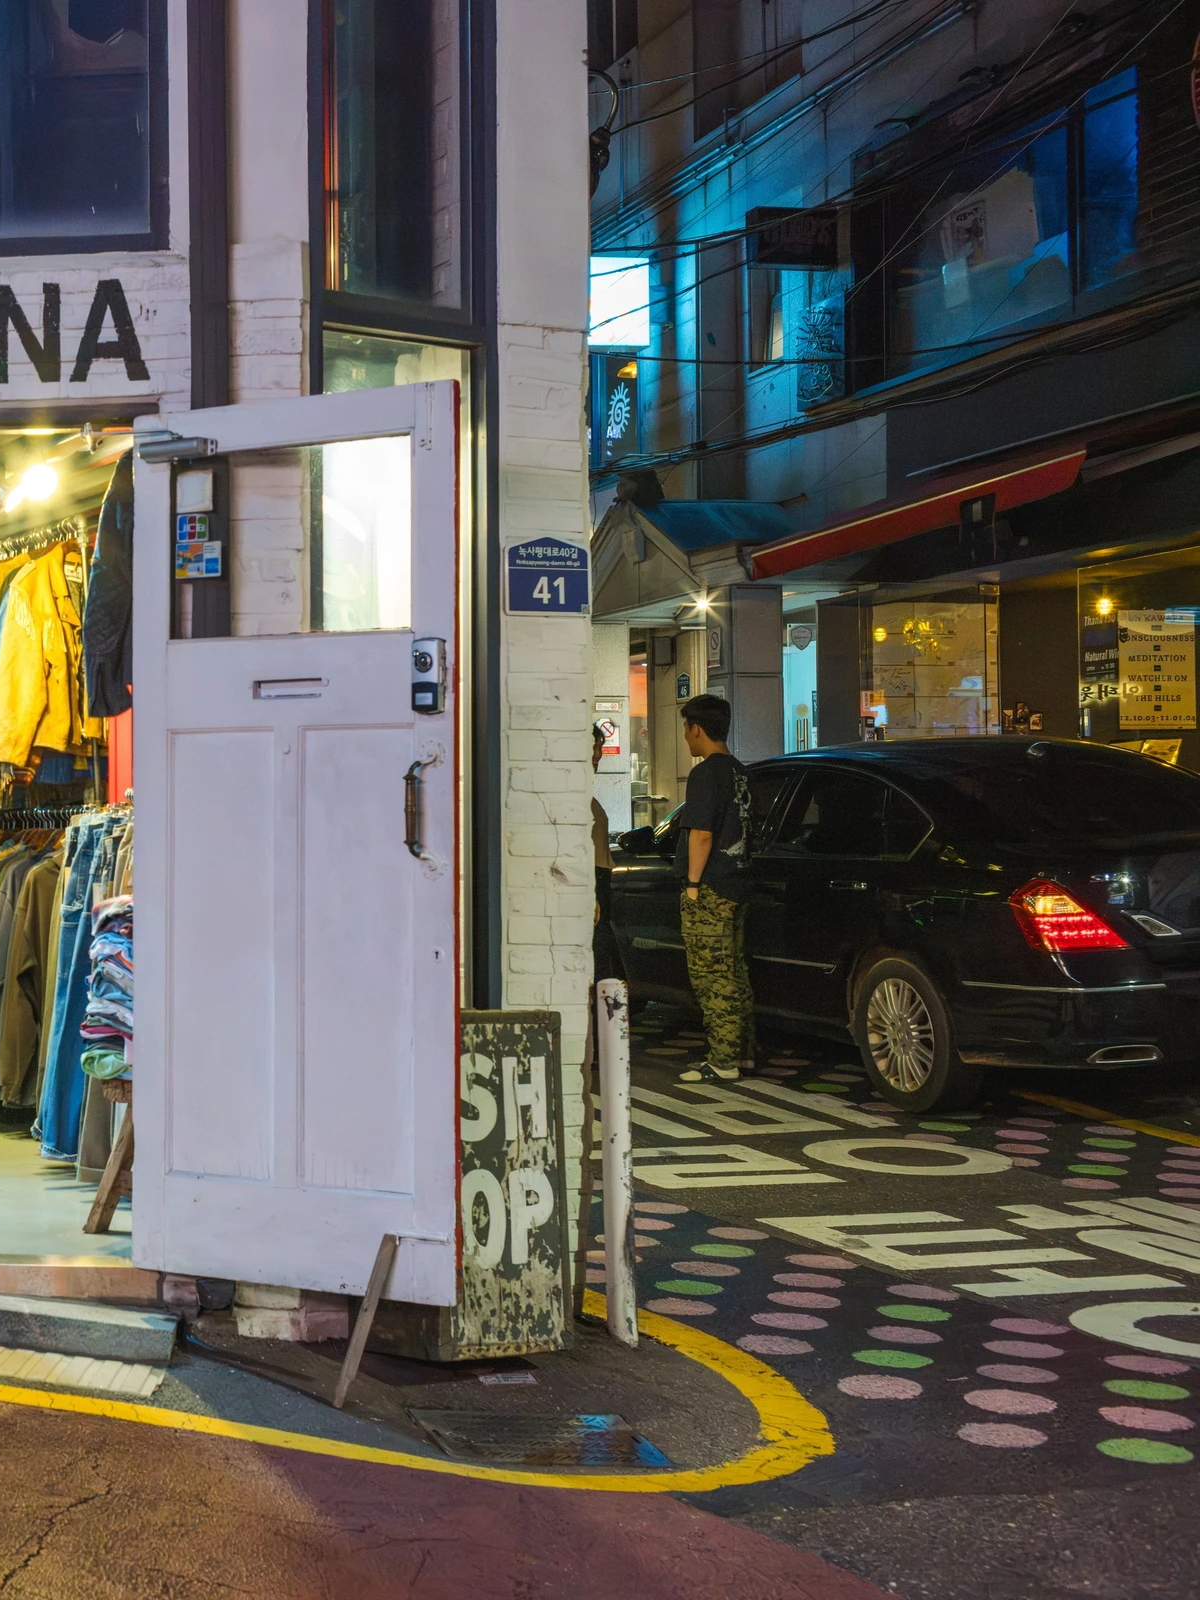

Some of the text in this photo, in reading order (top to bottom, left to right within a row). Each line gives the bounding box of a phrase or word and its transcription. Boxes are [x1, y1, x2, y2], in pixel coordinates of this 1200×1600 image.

[518, 546, 578, 559] 녹사평대로40길
[532, 576, 565, 604] 41
[1084, 649, 1108, 662] Natural
[1128, 654, 1186, 662] MEDITATION
[1127, 674, 1188, 682] WATCHER ON
[1135, 694, 1181, 702] THE HILLS
